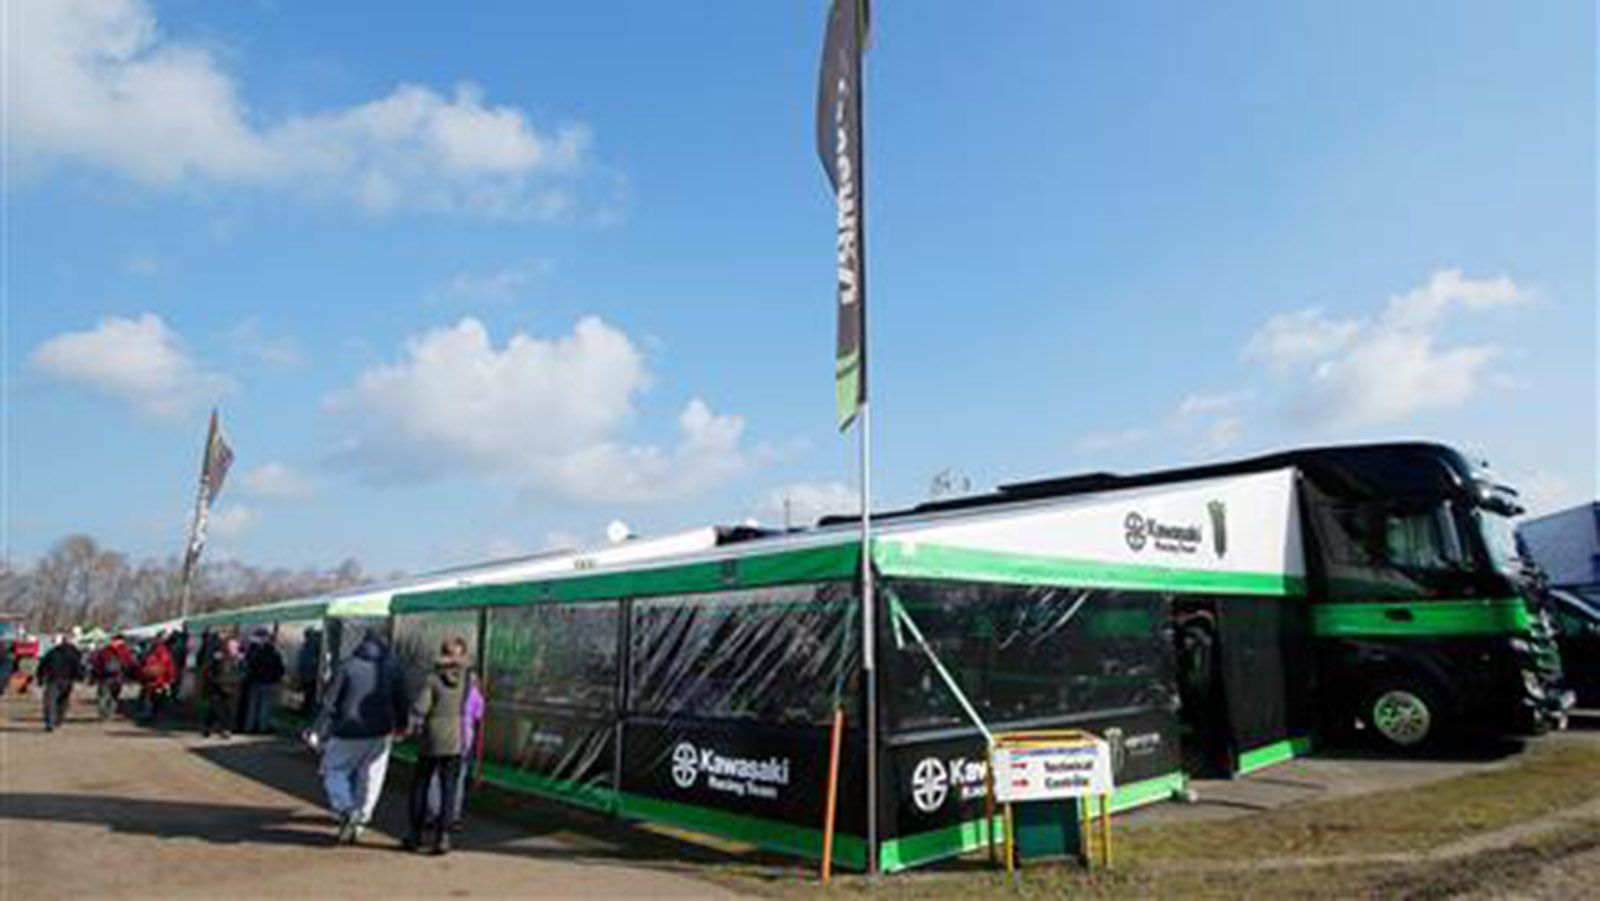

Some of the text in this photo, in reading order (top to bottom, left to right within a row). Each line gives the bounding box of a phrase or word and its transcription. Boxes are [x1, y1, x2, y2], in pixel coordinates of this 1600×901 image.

[1146, 518, 1202, 543] Kawasaki
[700, 748, 790, 784] Kawasaki
[708, 775, 778, 798] Racing Team
